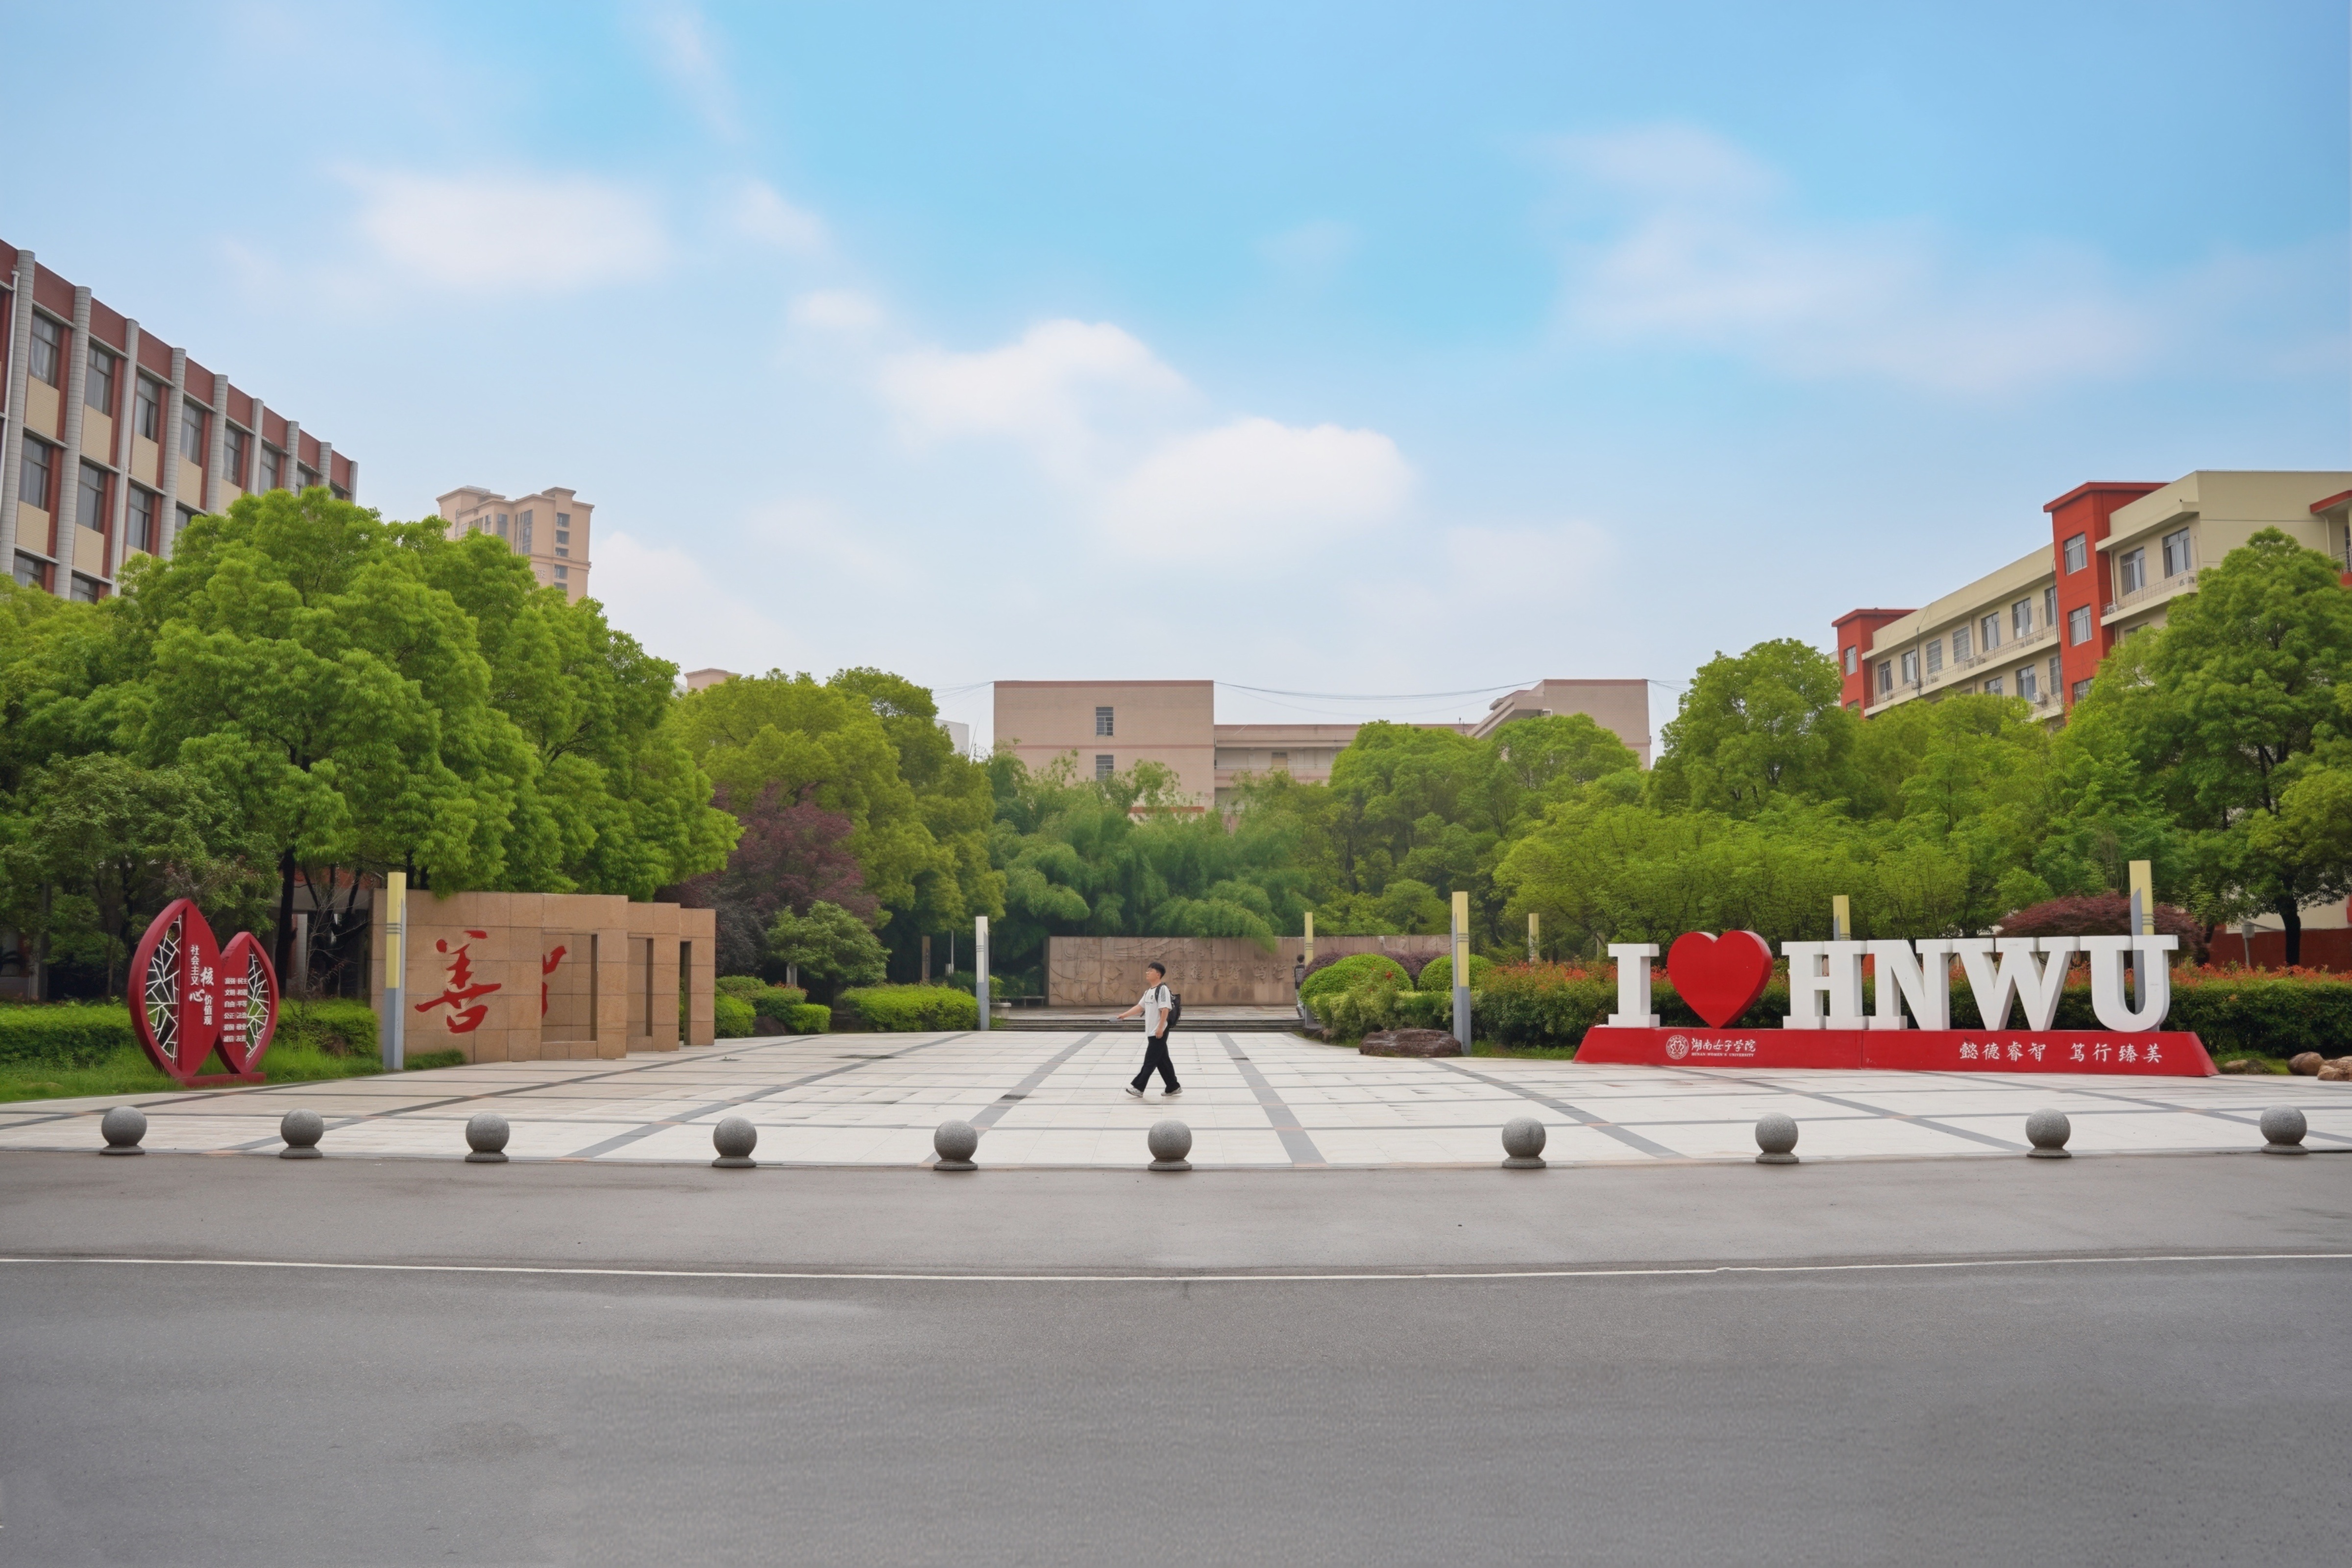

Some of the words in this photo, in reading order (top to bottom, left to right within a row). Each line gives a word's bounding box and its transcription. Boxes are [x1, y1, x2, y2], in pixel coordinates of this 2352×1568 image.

[190, 944, 200, 986] 社会主义
[1253, 963, 1295, 980] 笃行
[1608, 943, 1660, 1028] I
[1781, 934, 2179, 1032] HNWU
[203, 994, 213, 1026] 价值观
[1691, 1037, 1756, 1053] 湖南女子学院
[1960, 1041, 2047, 1062] 懿德睿智
[2069, 1043, 2162, 1064] 笃行臻美
